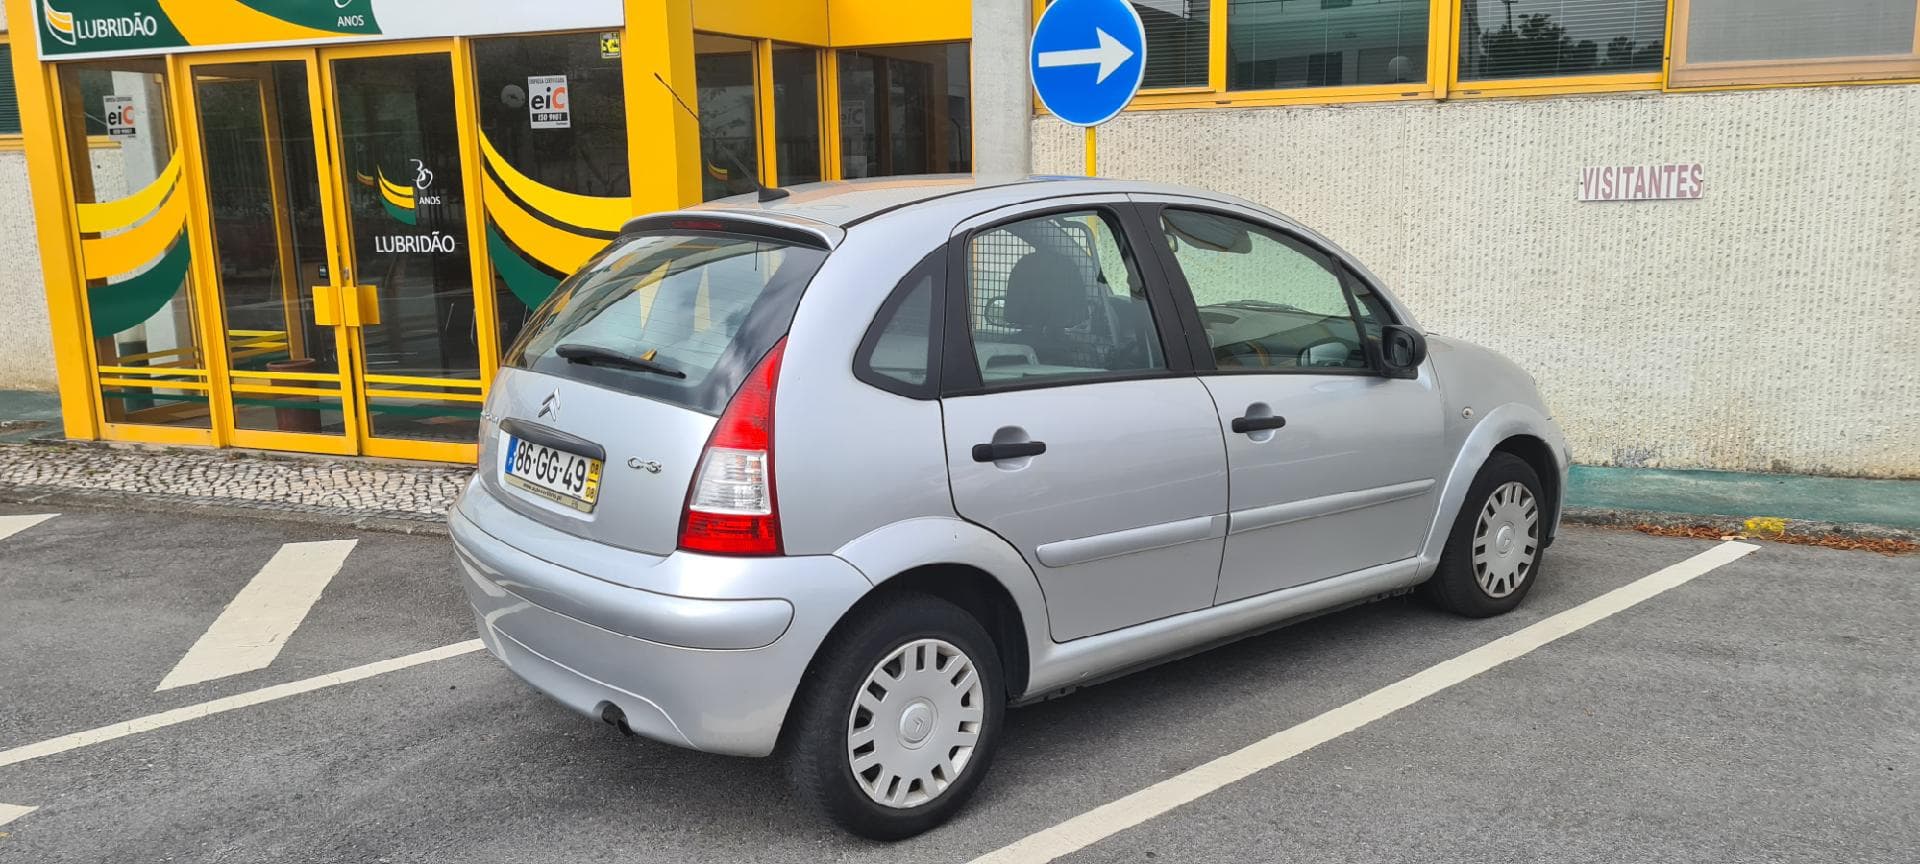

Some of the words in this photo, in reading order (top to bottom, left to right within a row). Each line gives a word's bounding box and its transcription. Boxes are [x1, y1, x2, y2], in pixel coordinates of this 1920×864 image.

[76, 11, 158, 39] LUBRIDÃO
[337, 14, 365, 28] ANOS
[531, 86, 567, 110] eiC
[108, 105, 135, 125] eiC
[537, 113, 548, 121] ISO
[1582, 163, 1703, 200] VISITANTES
[419, 196, 441, 205] ANOS
[375, 230, 456, 253] LUBRIDÃO
